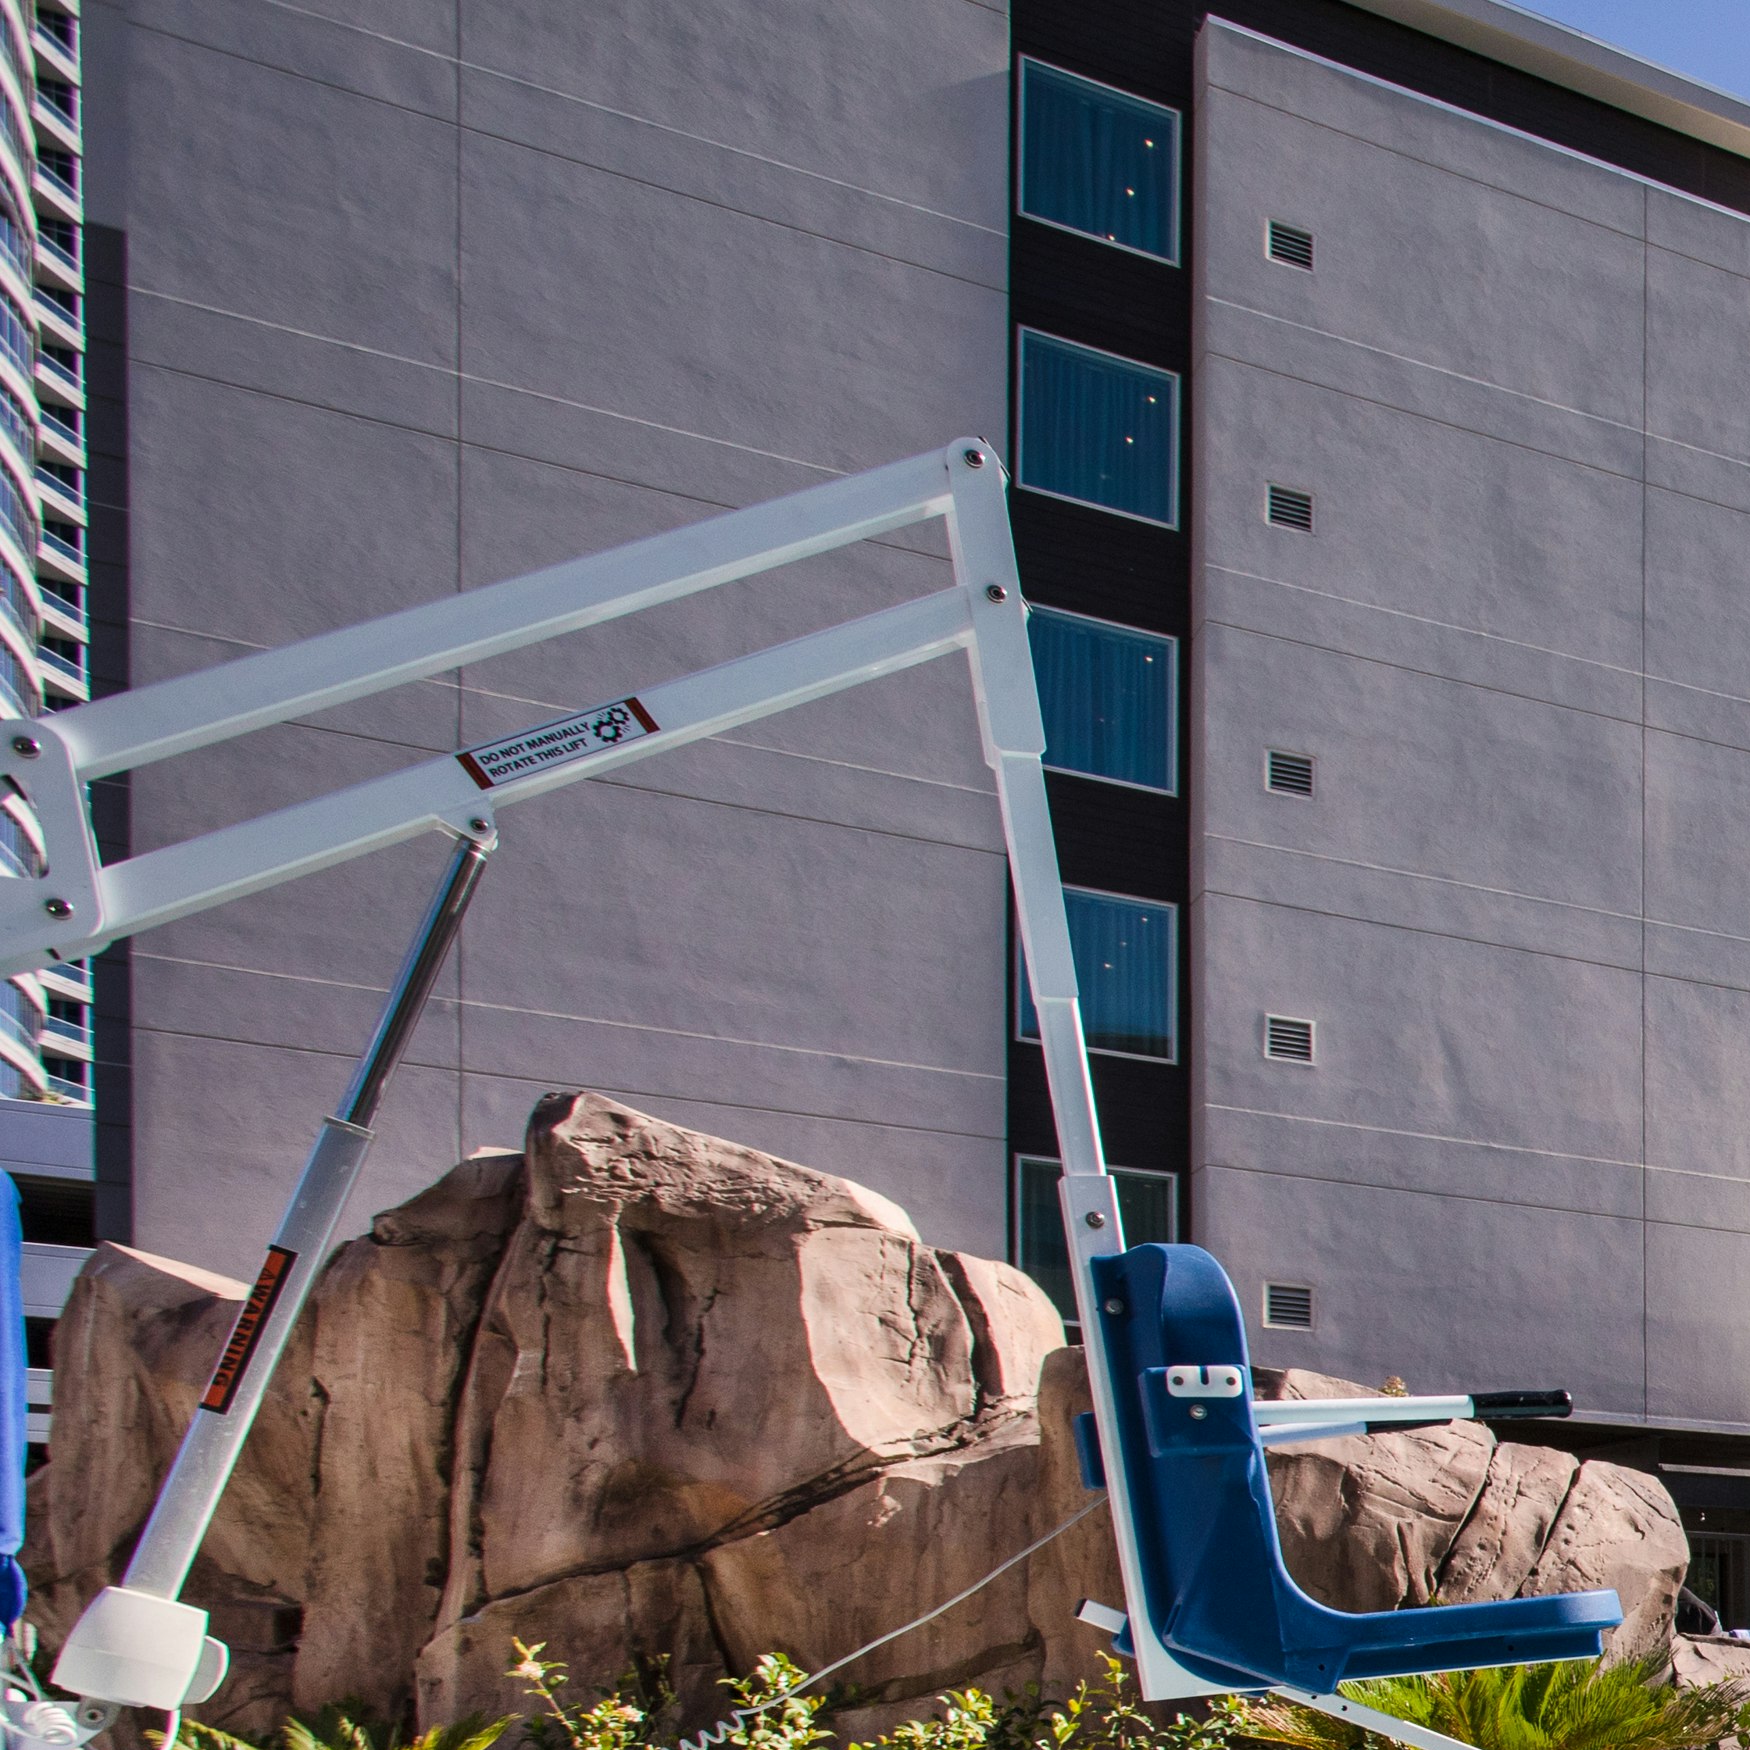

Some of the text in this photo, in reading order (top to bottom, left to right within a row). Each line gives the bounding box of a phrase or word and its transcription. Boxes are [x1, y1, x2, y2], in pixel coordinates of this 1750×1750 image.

[480, 721, 591, 765] DO NOT MANUALLY
[489, 738, 588, 778] ROTATE THIS LIFT
[212, 1284, 271, 1386] WARNING
